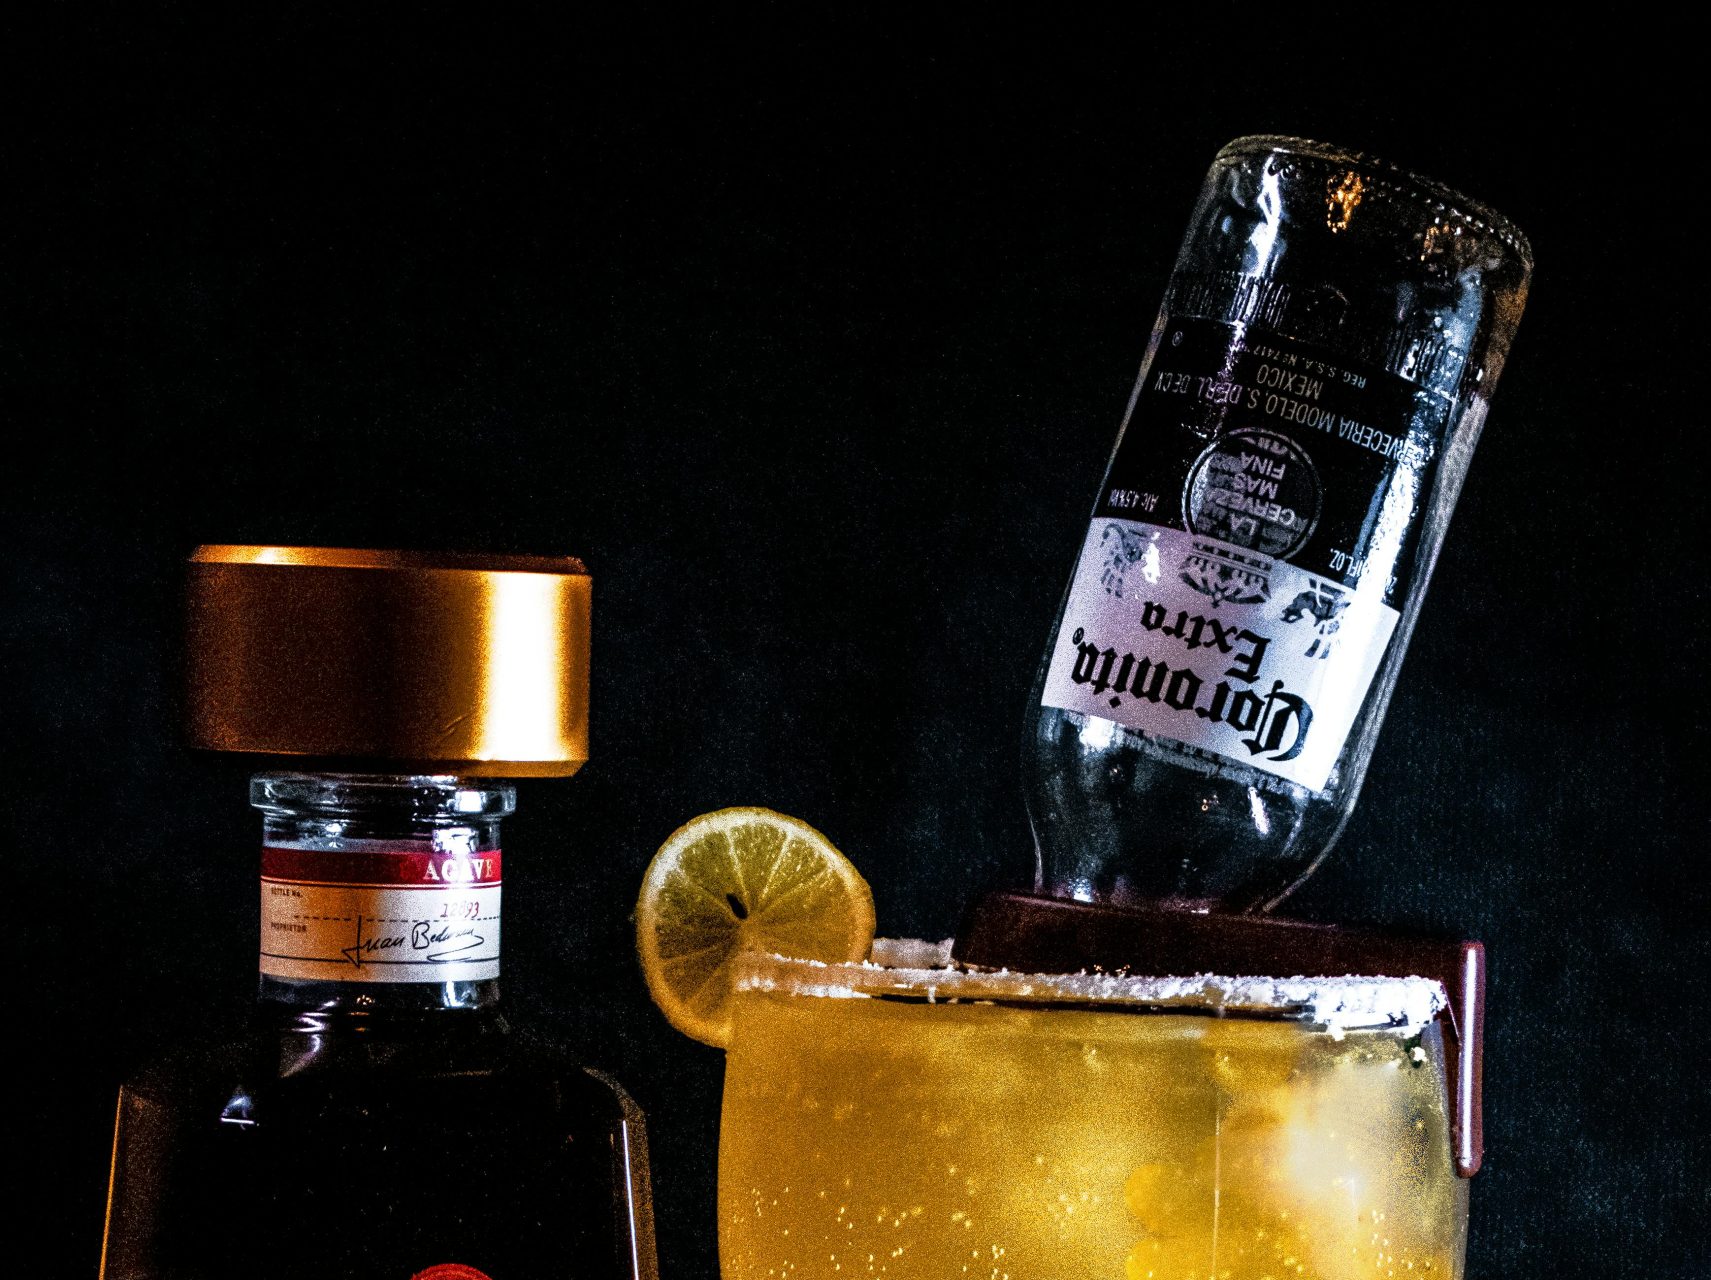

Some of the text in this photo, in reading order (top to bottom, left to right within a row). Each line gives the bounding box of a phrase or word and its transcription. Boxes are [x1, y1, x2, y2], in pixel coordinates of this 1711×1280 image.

[1254, 345, 1280, 360] 7417
[1257, 364, 1324, 400] MEXICO
[1341, 369, 1367, 390] REG.
[1247, 388, 1261, 409] S.
[1241, 452, 1286, 480] FINA
[1233, 472, 1278, 499] MAS
[1230, 512, 1257, 536] LA
[1140, 601, 1272, 684] Extra
[1071, 641, 1314, 762] Coronita
[423, 859, 493, 880] AGAVE
